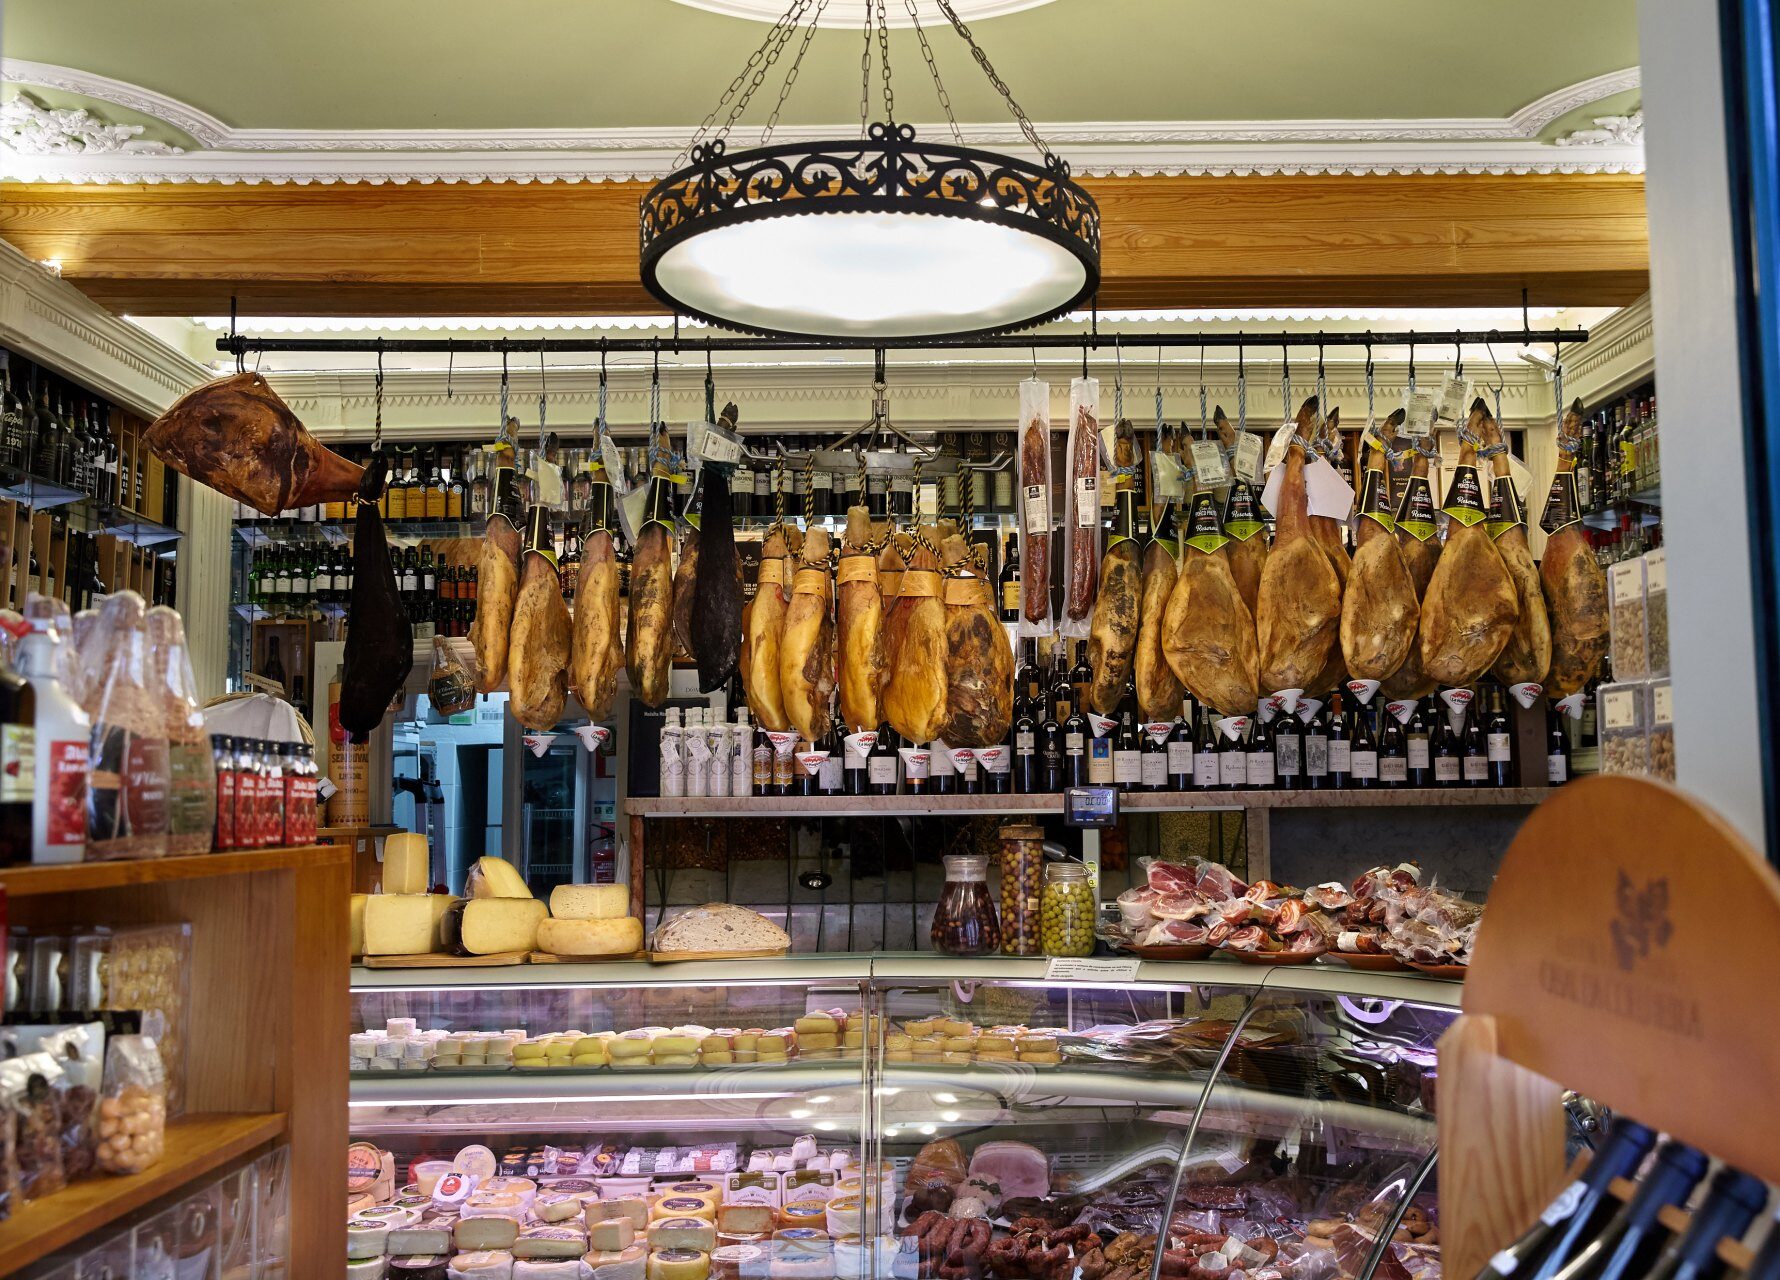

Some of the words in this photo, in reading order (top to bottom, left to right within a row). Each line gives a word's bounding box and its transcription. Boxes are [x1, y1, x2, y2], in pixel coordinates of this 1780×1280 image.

[1456, 495, 1478, 506] Reserva
[1231, 510, 1253, 518] Reserva
[1410, 509, 1432, 519] Reserva
[1464, 514, 1472, 522] 24
[1418, 528, 1426, 536] 24
